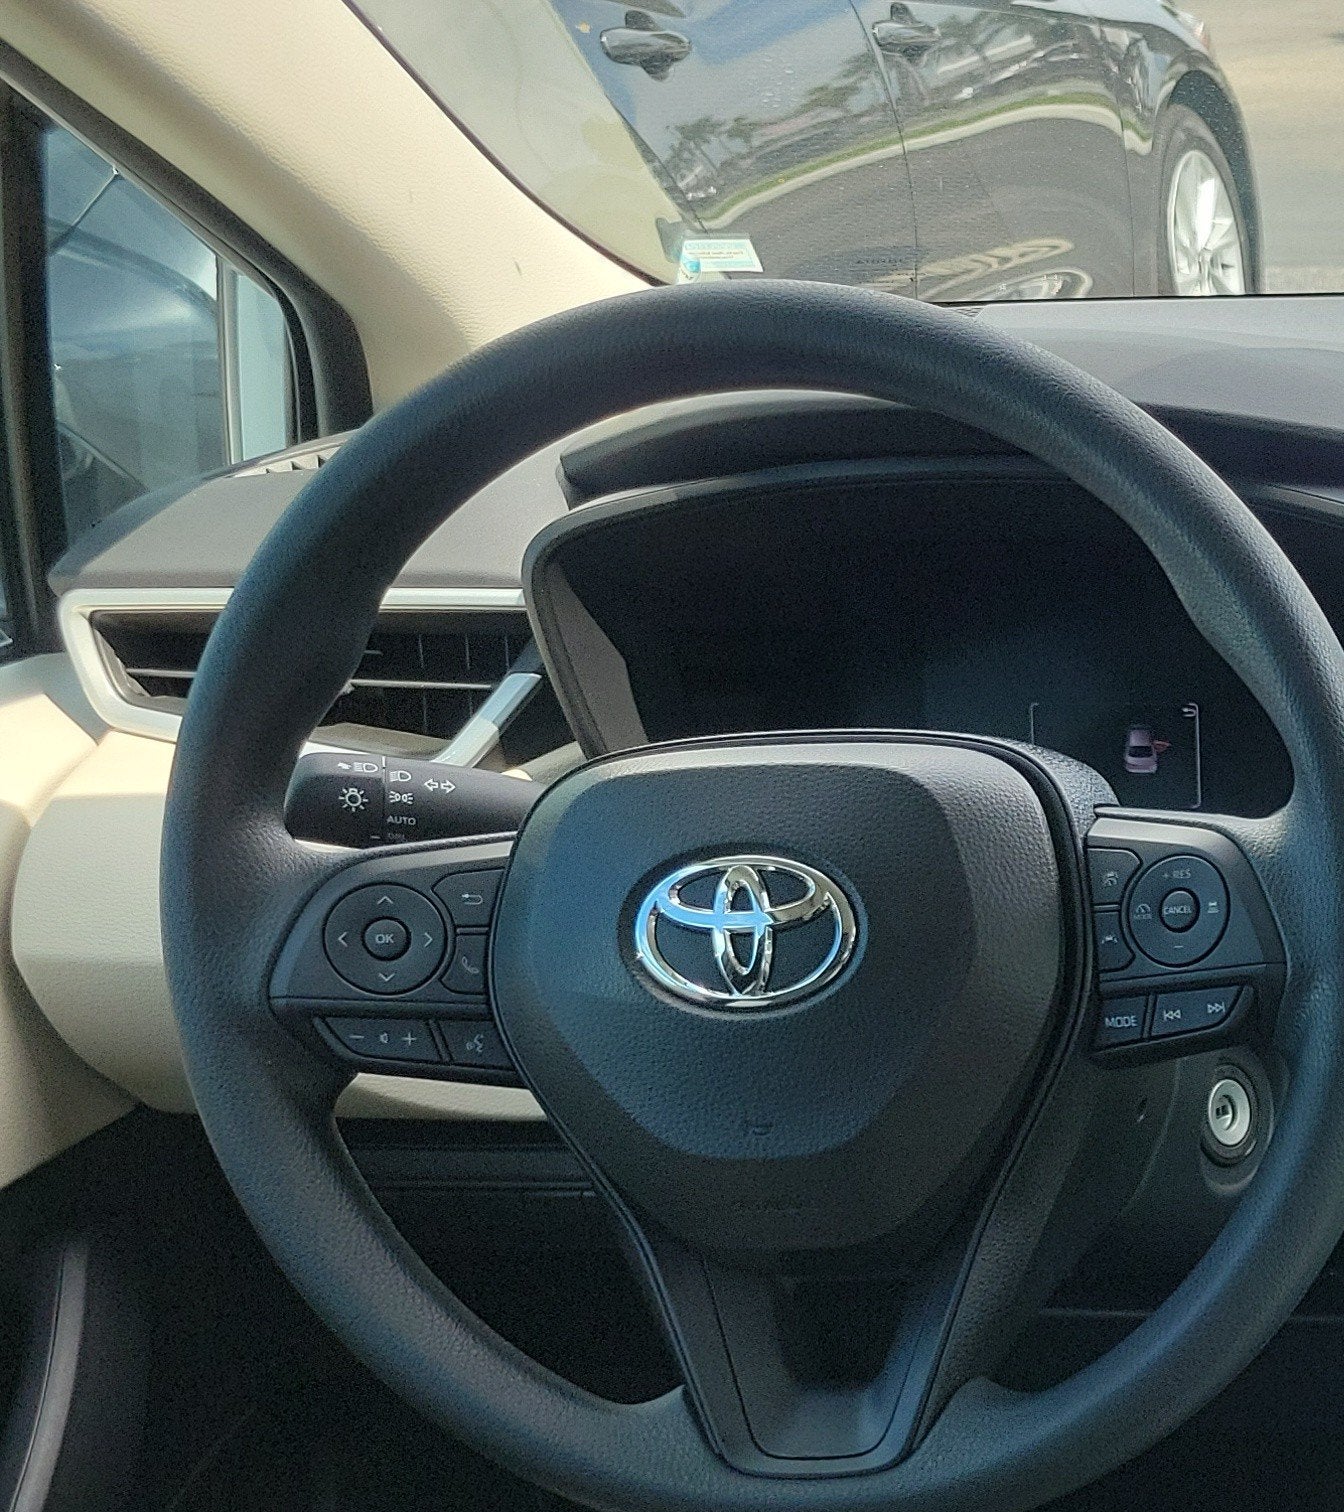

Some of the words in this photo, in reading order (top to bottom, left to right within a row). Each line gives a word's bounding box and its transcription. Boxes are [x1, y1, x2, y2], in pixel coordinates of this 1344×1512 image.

[386, 815, 417, 826] AUTO
[1163, 906, 1193, 915] CANCEL
[375, 933, 395, 944] OK
[1105, 1016, 1138, 1029] MODE
